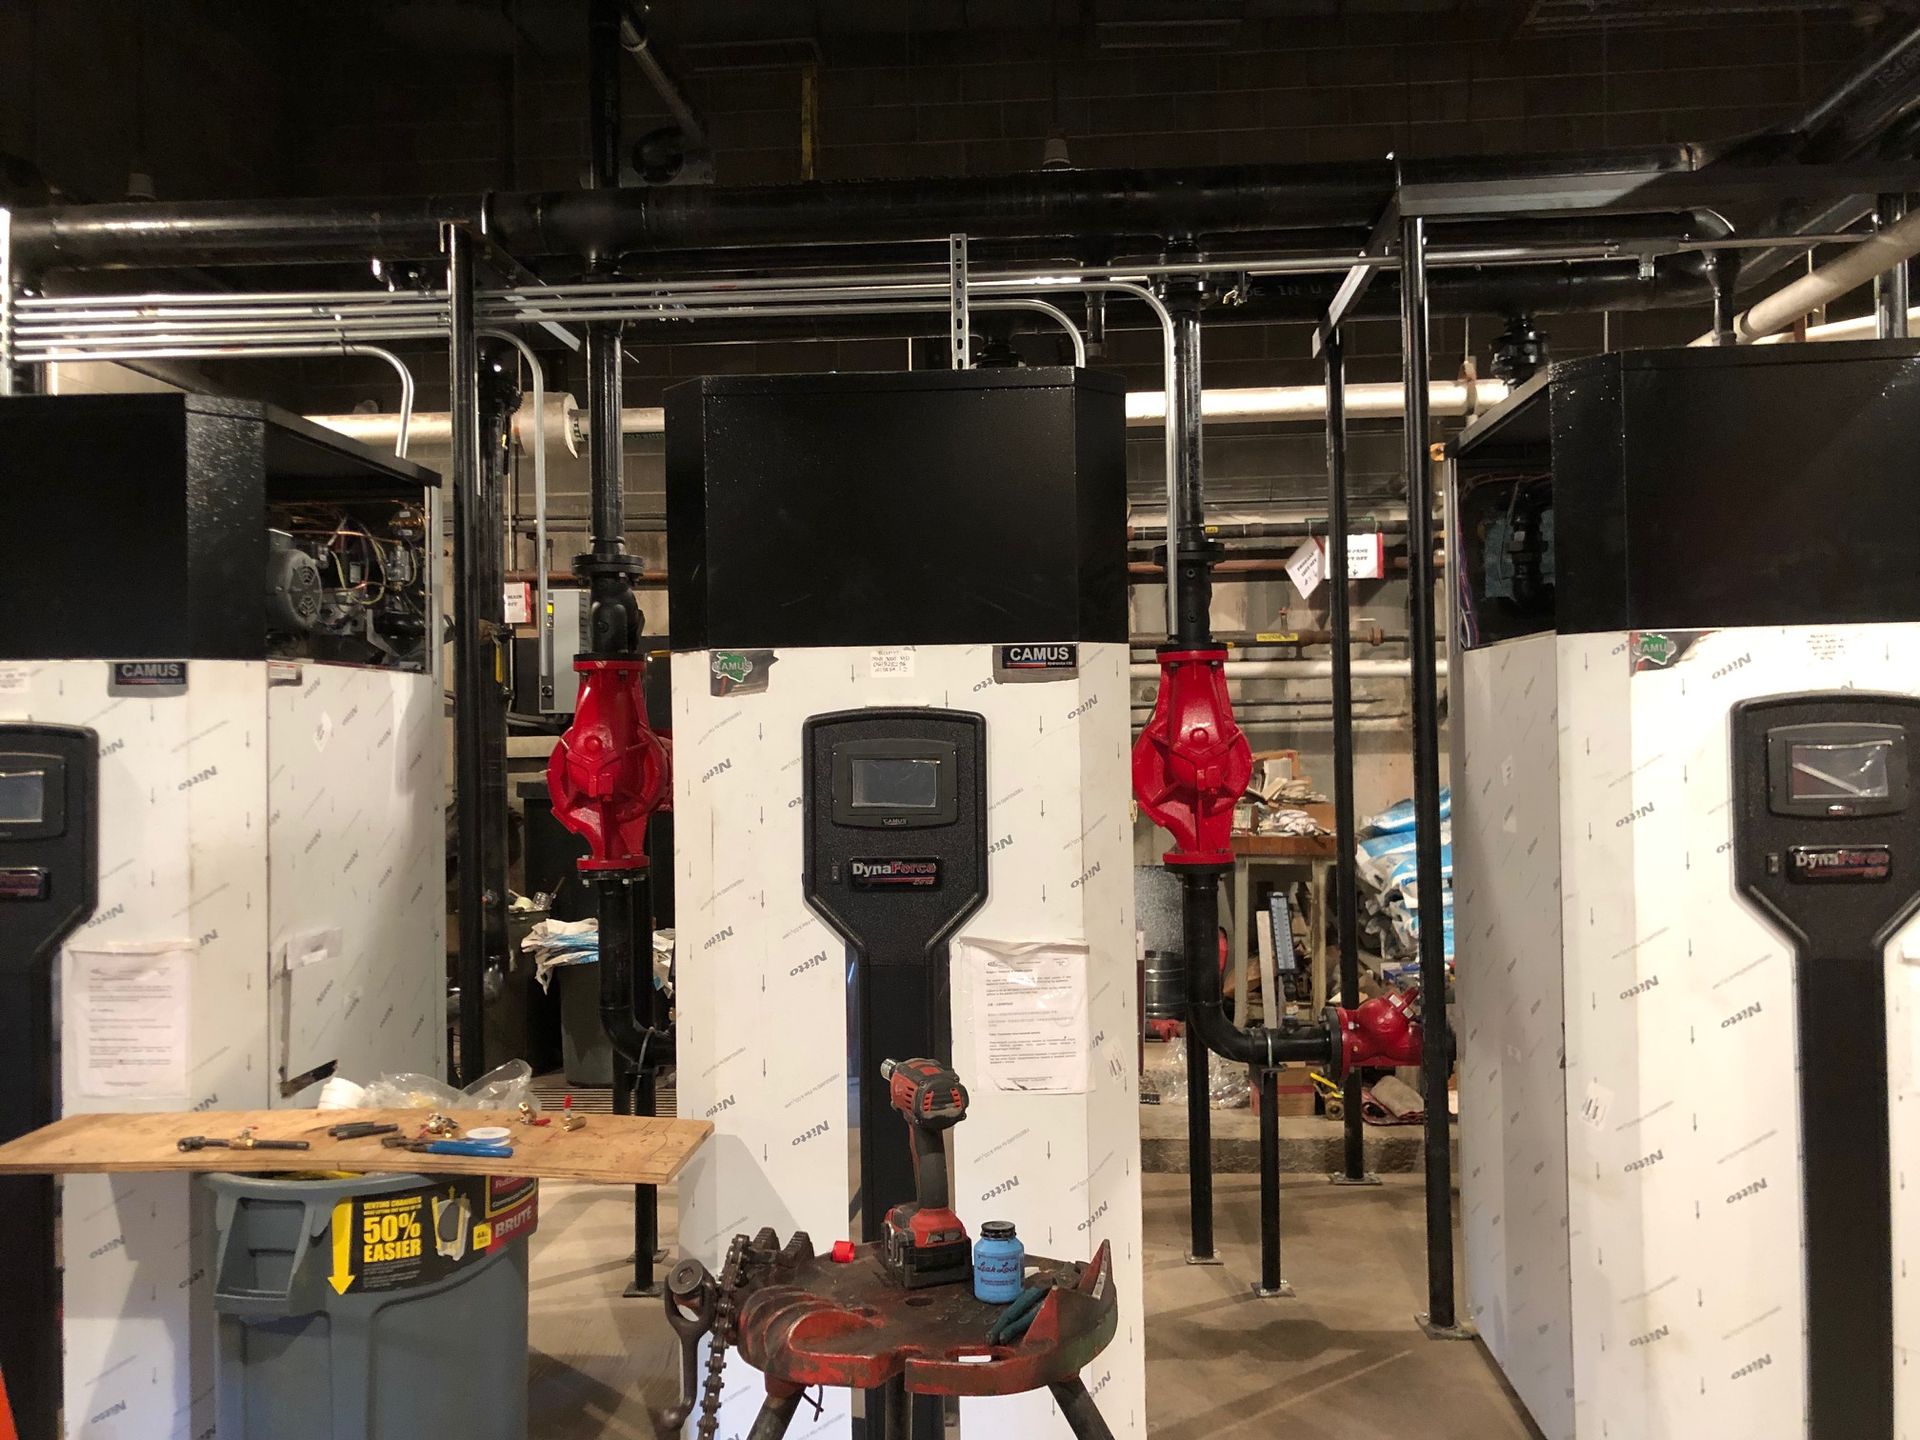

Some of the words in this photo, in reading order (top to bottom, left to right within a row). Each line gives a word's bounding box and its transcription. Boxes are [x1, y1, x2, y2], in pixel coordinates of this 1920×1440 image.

[1009, 646, 1070, 661] CAMUS
[1711, 652, 1752, 680] Nitto
[121, 664, 179, 677] CAMUS
[1067, 694, 1098, 720] Nitto
[178, 765, 218, 791] Nitto
[701, 758, 733, 784] Nitto
[1616, 802, 1655, 828] Nitto
[852, 860, 937, 878] DynaForce
[1071, 861, 1101, 891] Nitto
[87, 903, 125, 929] Nitto
[704, 926, 735, 950] Nitto
[789, 950, 830, 978] Nitto
[1620, 975, 1660, 1000] Nitto
[1721, 1002, 1763, 1029] Nitto
[705, 1094, 736, 1118] Nitto
[791, 1119, 831, 1146] Nitto
[1624, 1150, 1664, 1173] Nitto
[981, 1175, 1020, 1203] Nitto
[1726, 1178, 1768, 1204] Nitto
[363, 1211, 423, 1244] 50%
[495, 1205, 532, 1238] BRUTE
[1077, 1201, 1108, 1232] Nitto
[89, 1234, 126, 1259] Nitto
[363, 1238, 422, 1263] EASIER
[977, 1261, 997, 1273] Leak
[1630, 1325, 1670, 1347] Nitto
[1732, 1354, 1772, 1380] Nitto
[91, 1400, 127, 1425] Nitto
